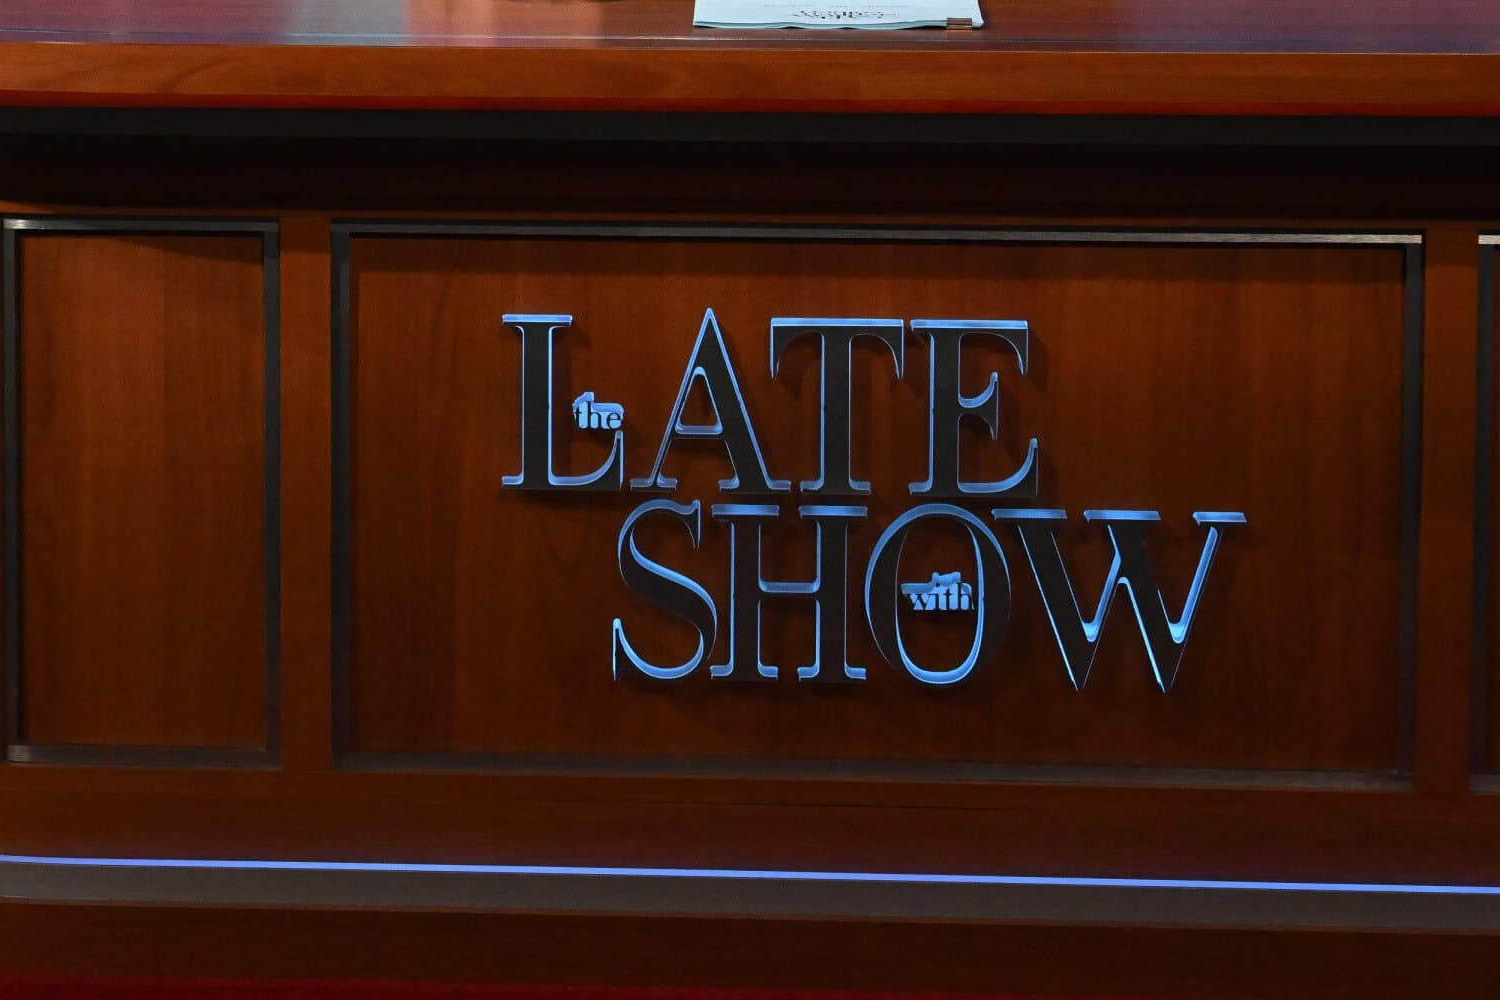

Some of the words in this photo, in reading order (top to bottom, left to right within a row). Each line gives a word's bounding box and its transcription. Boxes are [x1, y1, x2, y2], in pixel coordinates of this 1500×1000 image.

[501, 306, 1039, 496] LATE
[572, 392, 624, 430] the
[613, 500, 1246, 692] SHOW
[901, 572, 975, 611] with
